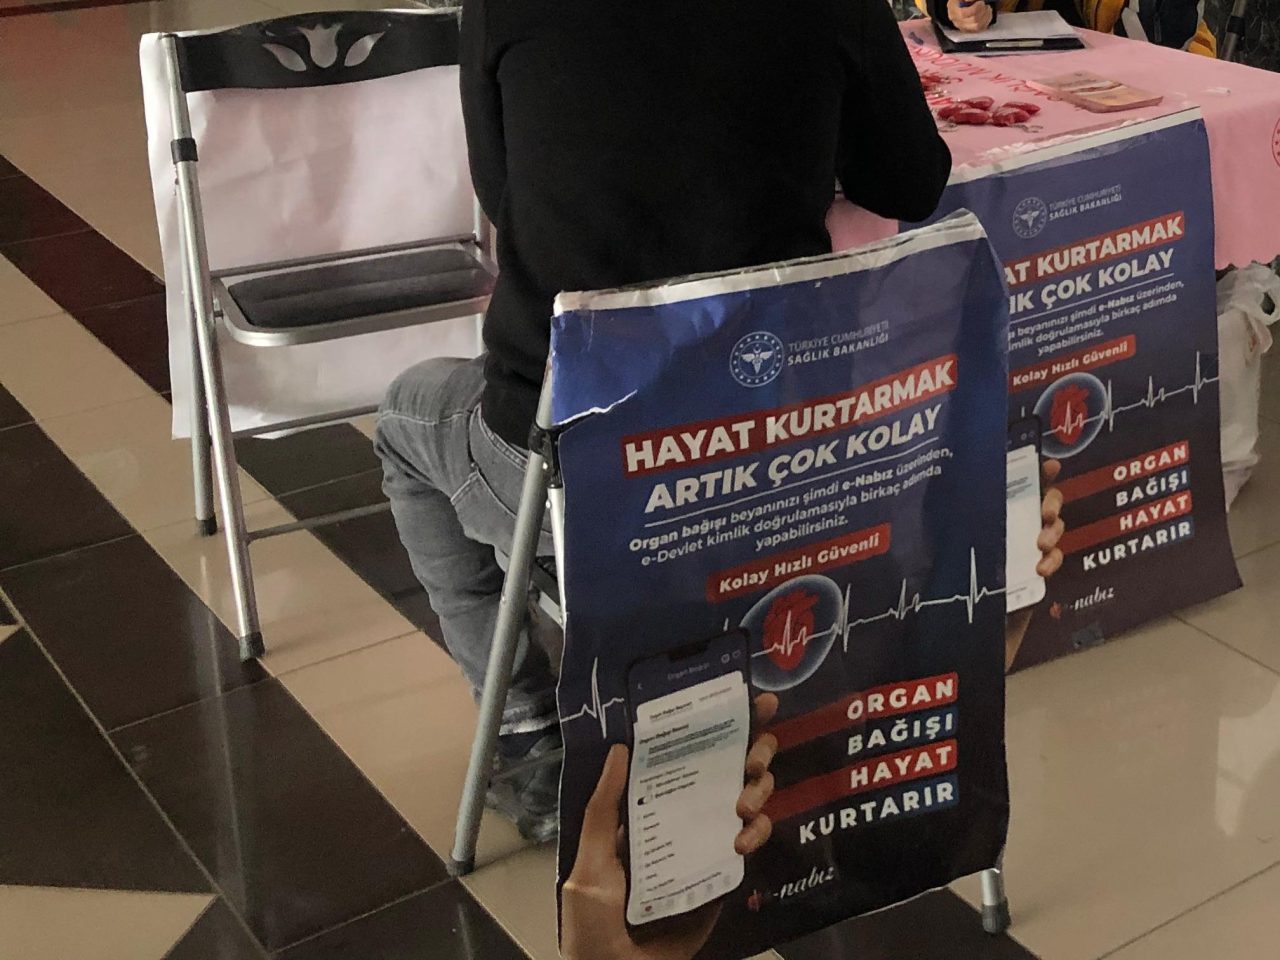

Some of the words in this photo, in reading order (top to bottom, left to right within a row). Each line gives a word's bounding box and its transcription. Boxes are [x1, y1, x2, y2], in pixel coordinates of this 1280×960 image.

[1037, 216, 1182, 277] KURTARMAK
[1041, 275, 1092, 310] ÇOK
[1098, 248, 1174, 287] KOLAY
[1070, 304, 1097, 323] şimdi
[1112, 304, 1141, 321] birkaç
[788, 349, 830, 366] SAĞLIK
[833, 332, 889, 357] BAKANLIĞI
[1013, 368, 1048, 387] Kolay
[1052, 357, 1080, 375] Hızlı
[1083, 342, 1128, 364] Güvenli
[625, 420, 758, 473] HAYAT
[765, 360, 955, 442] KURTARMAK
[645, 461, 758, 514] ARTIK
[767, 438, 839, 488] ÇOK
[845, 404, 942, 460] KOLAY
[1113, 445, 1187, 481] ORGAN
[628, 529, 679, 552] Organ
[682, 517, 727, 540] bağışı
[730, 495, 801, 523] beyanınızı
[803, 481, 839, 505] şimdi
[841, 468, 893, 491] e-Nabız
[896, 447, 954, 476] üzerinden,
[1115, 469, 1188, 507] BAĞIŞI
[641, 540, 703, 566] e-Devlet
[706, 523, 751, 547] kimlik
[754, 493, 858, 534] doğrulamasıyla
[860, 482, 901, 503] birkaç
[755, 515, 849, 552] yapabilirsiniz.
[1120, 495, 1189, 531] HAYAT
[719, 568, 769, 594] Kolay
[774, 554, 813, 576] Hızlı
[818, 533, 880, 565] Güvenli
[1082, 522, 1191, 571] KURTARIR
[846, 677, 954, 720] ORGAN
[846, 713, 954, 756] BAĞIŞI
[850, 746, 952, 789] HAYAT
[799, 782, 954, 844] KURTARIR
